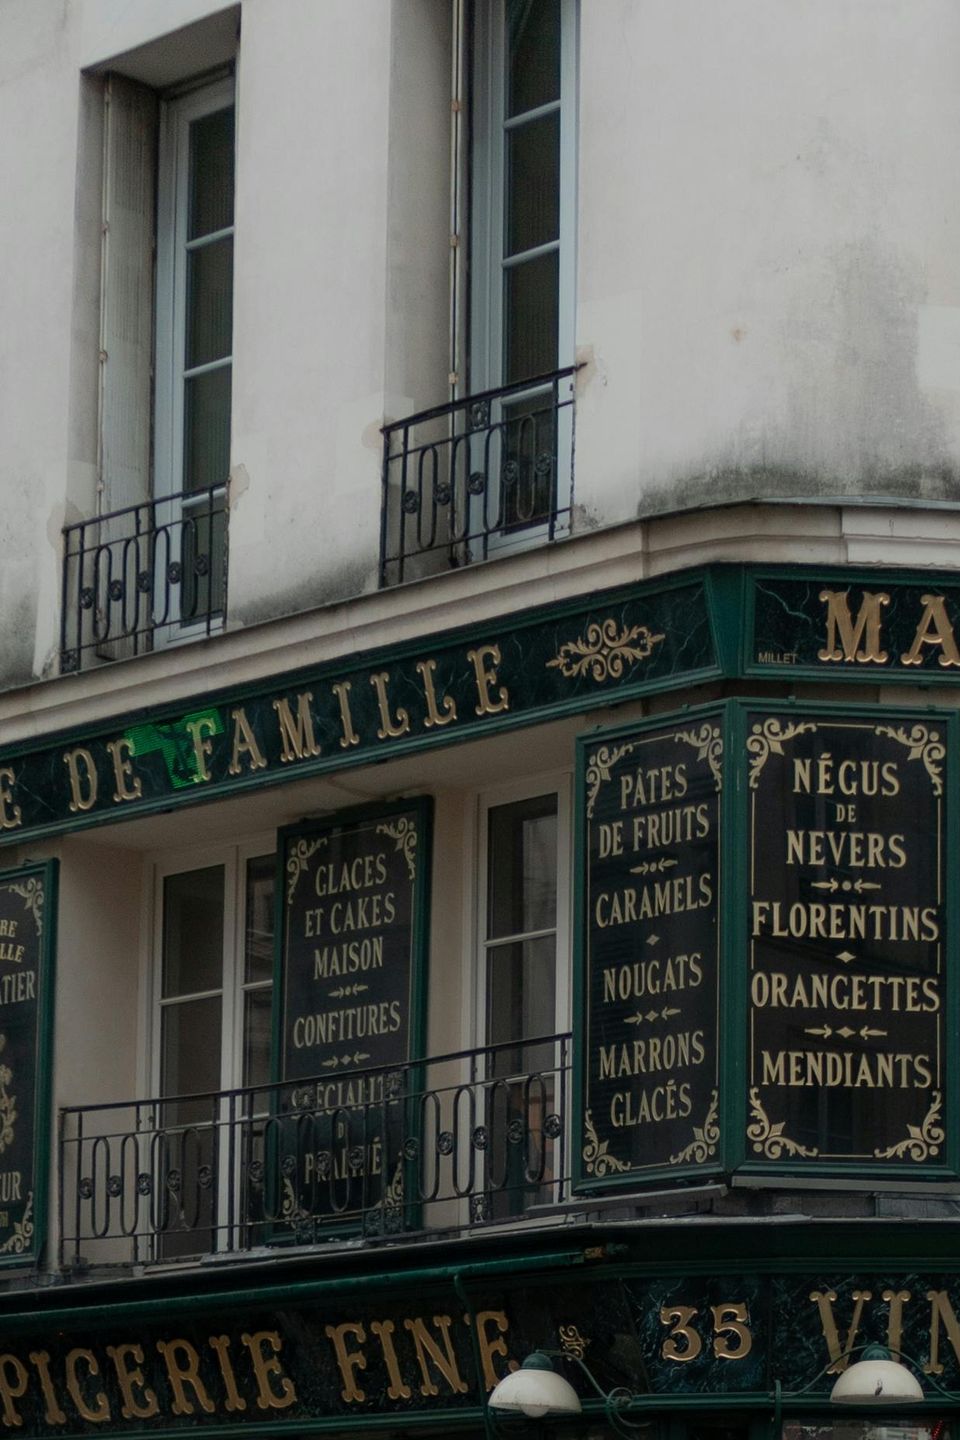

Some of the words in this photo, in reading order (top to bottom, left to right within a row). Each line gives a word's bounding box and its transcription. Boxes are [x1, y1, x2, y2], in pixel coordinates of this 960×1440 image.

[758, 652, 798, 665] MILLET
[63, 737, 142, 812] DE
[186, 644, 509, 783] FAMILLE
[619, 762, 688, 810] PÂTES
[792, 752, 900, 796] NÉGUS
[598, 820, 624, 859] DE
[633, 803, 710, 852] FRUITS
[836, 804, 857, 823] DE
[785, 830, 907, 868] NEVERS
[315, 853, 387, 898] GLACES
[304, 908, 325, 939] ET
[330, 892, 396, 934] CAKES
[595, 873, 713, 928] CARAMELS
[751, 901, 939, 941] FLORENTINS
[313, 935, 384, 981] MAISON
[602, 952, 703, 1003] NOUGATS
[750, 971, 941, 1012] ORANGETTES
[293, 1000, 401, 1050] CONFITURES
[598, 1030, 705, 1080] MARRONS
[762, 1050, 933, 1089] MENDIANTS
[610, 1077, 693, 1128] GLACÉS
[660, 1301, 753, 1362] 35
